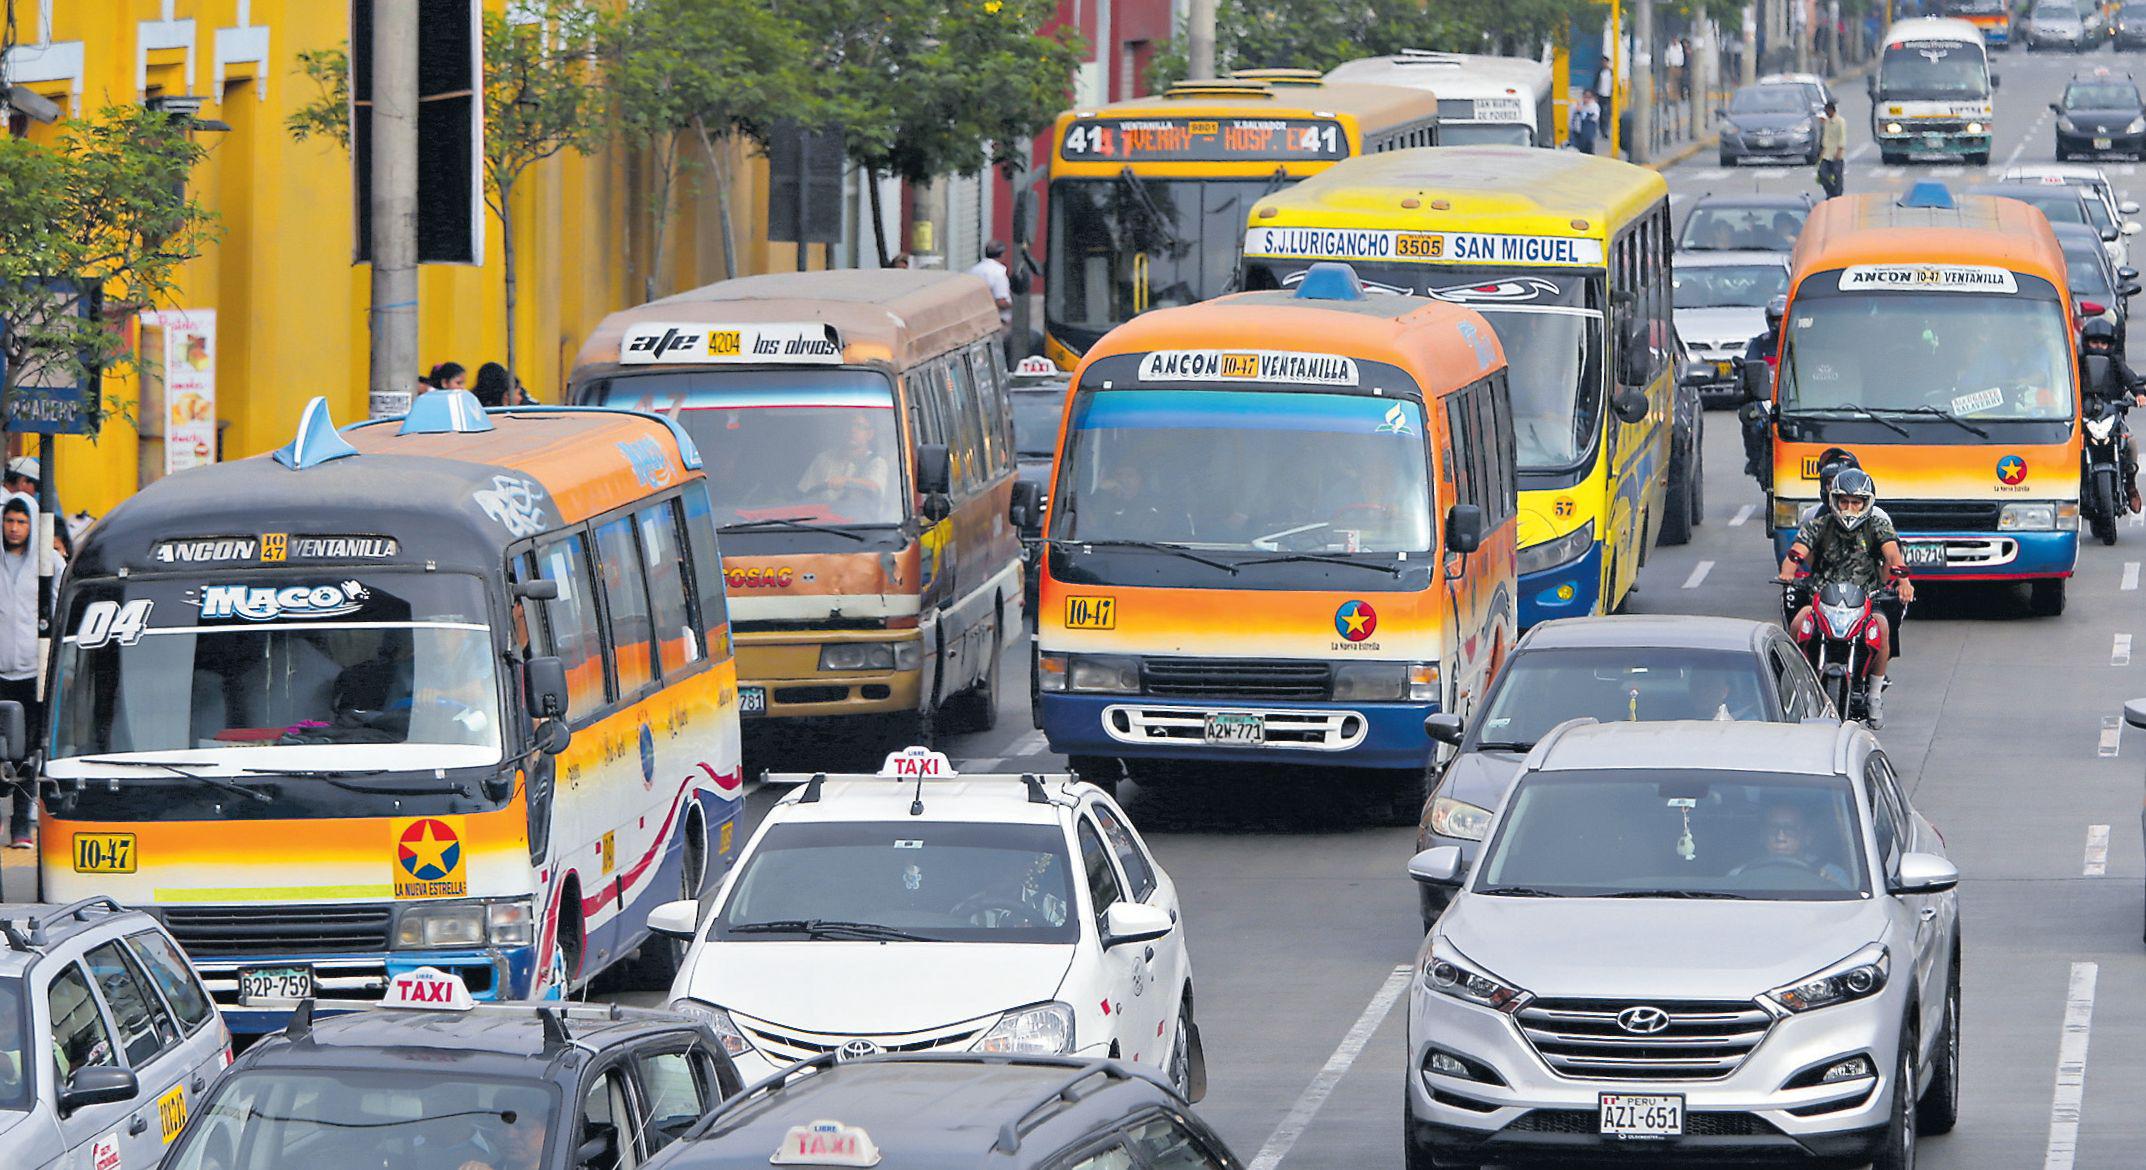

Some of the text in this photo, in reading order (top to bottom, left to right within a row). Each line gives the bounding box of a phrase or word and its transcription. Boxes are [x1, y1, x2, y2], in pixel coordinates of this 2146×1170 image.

[1067, 126, 1102, 153] 41
[1301, 125, 1337, 153] 41
[1264, 230, 1579, 262] S.J.LURIGANCHO 3505 SAN MIGUEL
[1853, 271, 2005, 284] ANCON 10-47 VENTANILLA
[708, 332, 741, 354] 4204
[753, 333, 780, 354] los
[1024, 363, 1049, 372] TAXI
[1150, 354, 1349, 380] ANCON 10-47 VENTANILLA
[10, 399, 78, 421] ARADERO
[1555, 502, 1574, 516] 57
[156, 540, 256, 563] ANCON
[291, 538, 398, 558] VENTANILLA
[76, 599, 155, 649] 04
[1069, 599, 1111, 626] 10-47
[1331, 641, 1380, 651] La Nueva Estrella
[1207, 723, 1262, 740] A2W-771
[894, 758, 939, 775] TAXI
[79, 838, 131, 868] 10-47
[395, 881, 463, 896] LA NUEVA ESTRELLA
[243, 975, 309, 998] B2P-759
[397, 980, 453, 1003] TAXI
[1627, 1097, 1657, 1106] PERU
[813, 1125, 837, 1133] LIBRE
[1603, 1106, 1679, 1129] AZI-651
[797, 1132, 856, 1156] TAXI
